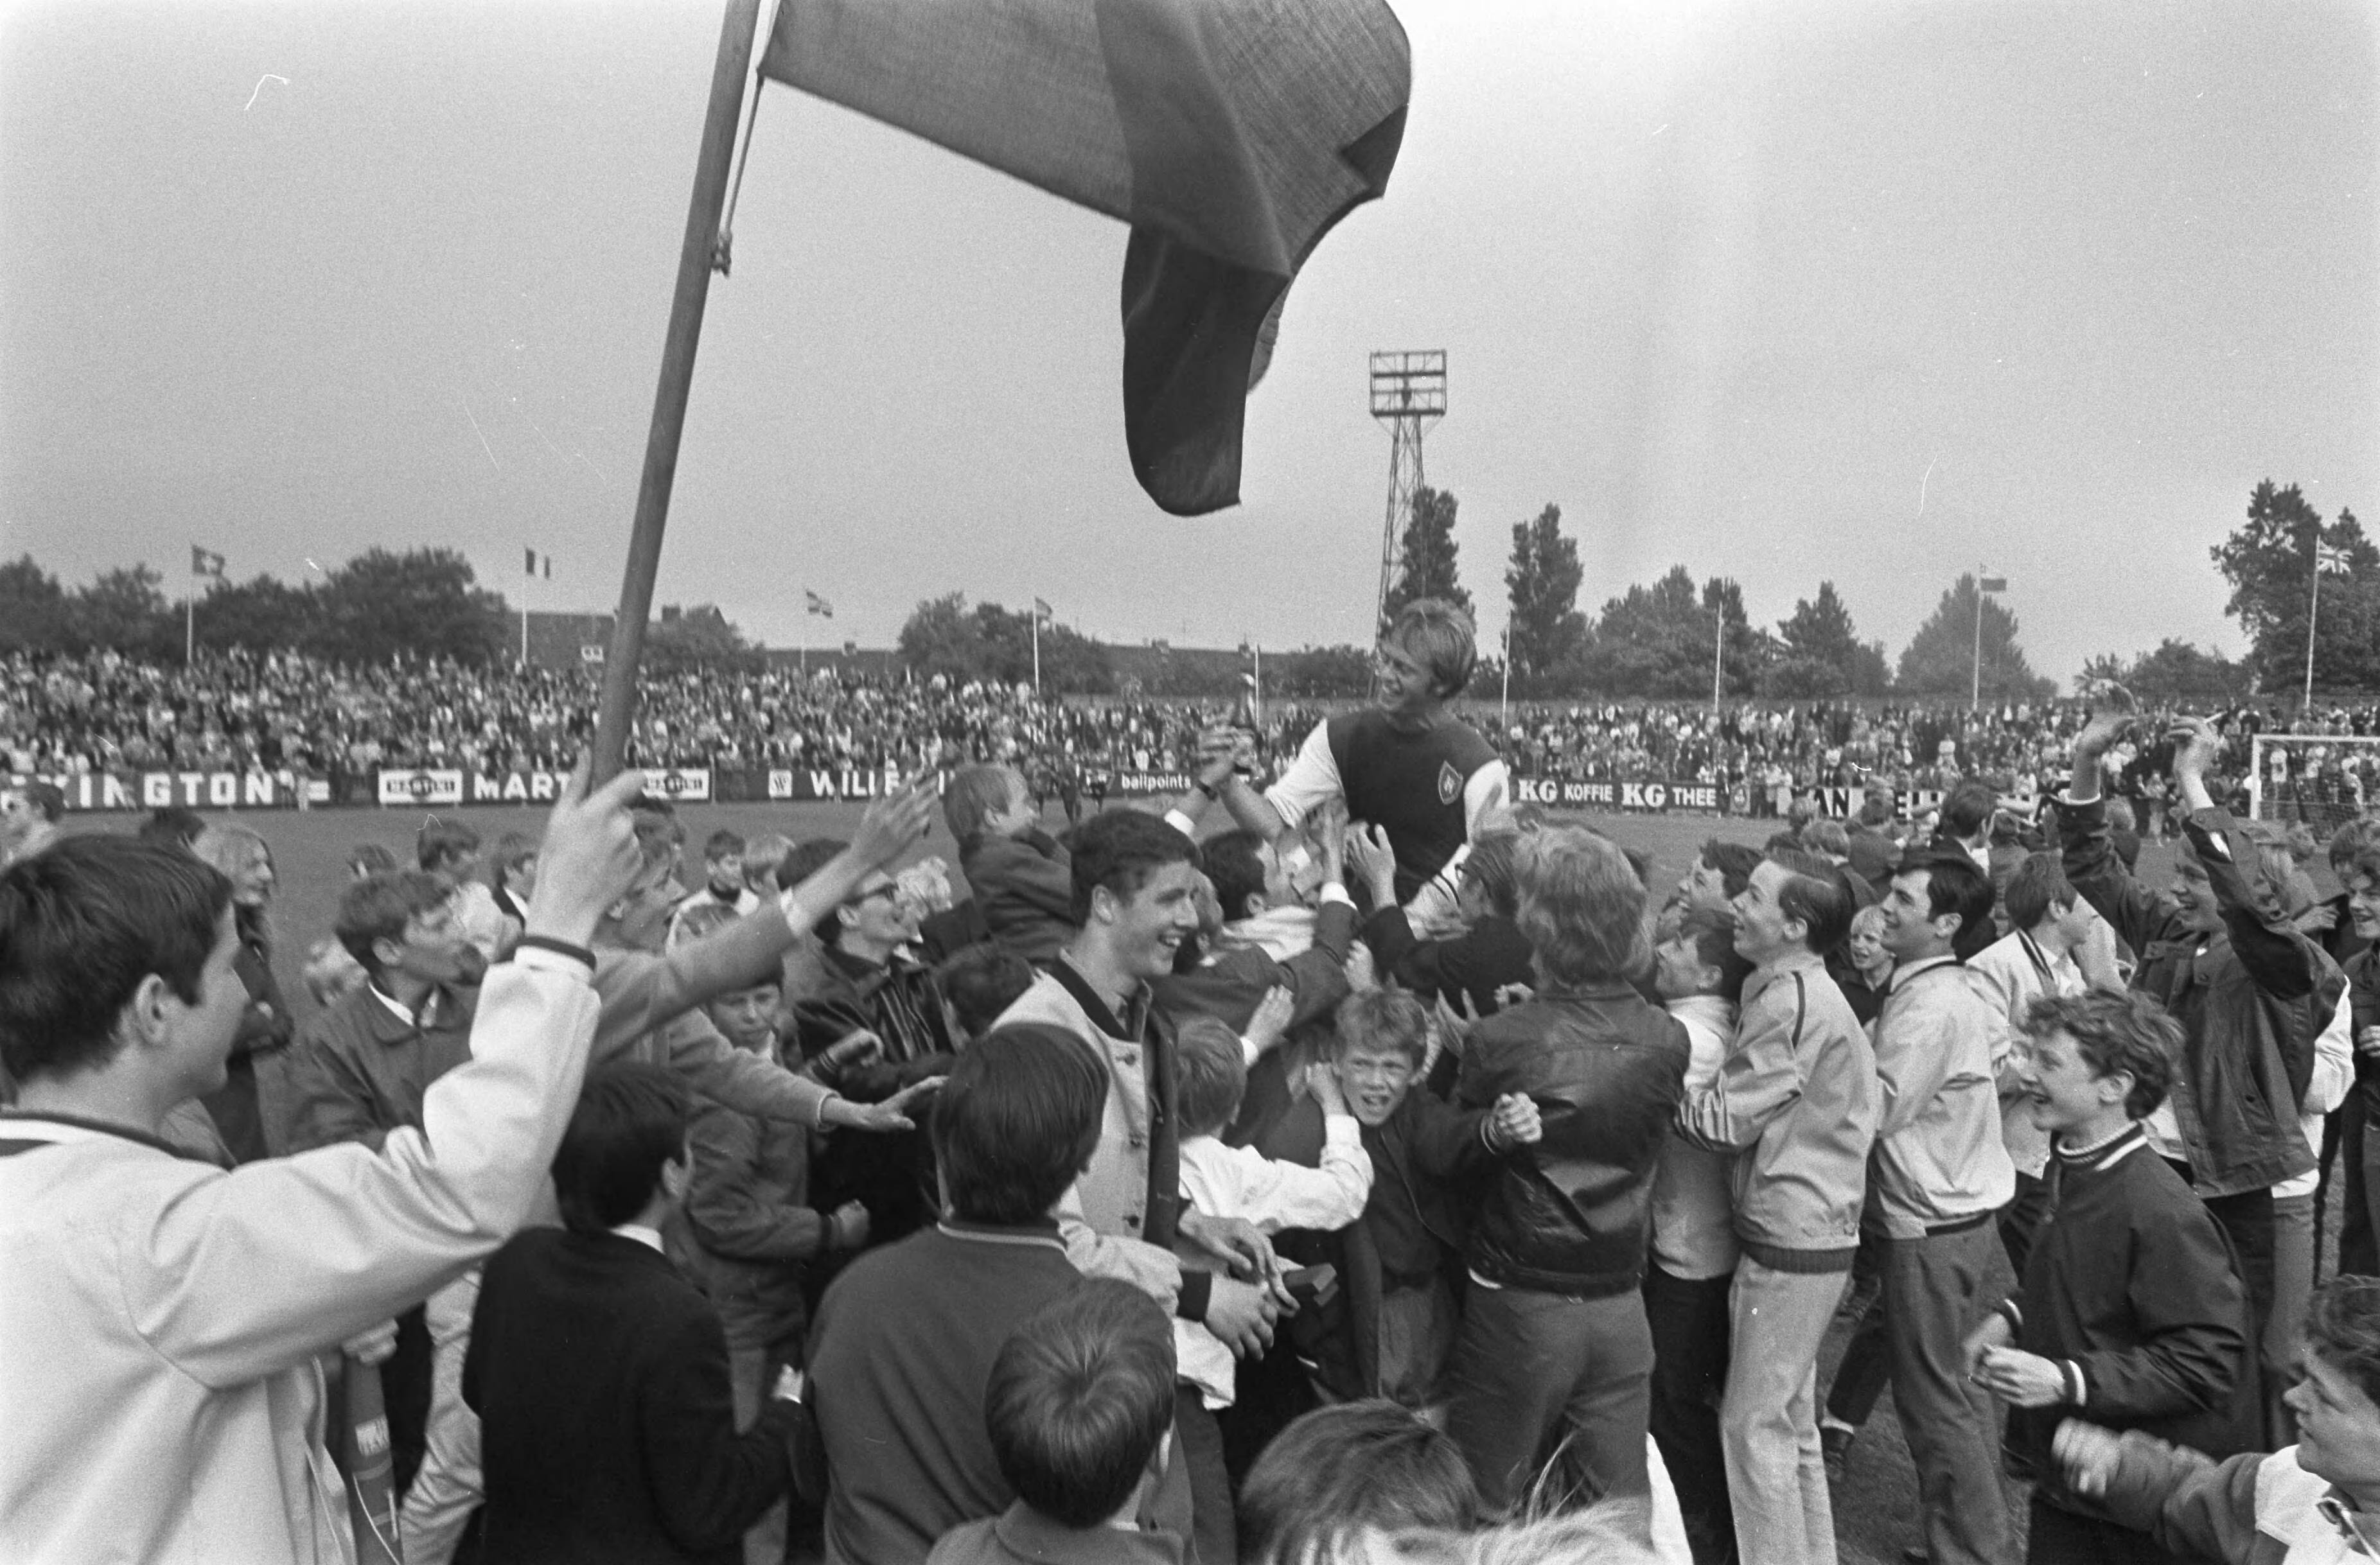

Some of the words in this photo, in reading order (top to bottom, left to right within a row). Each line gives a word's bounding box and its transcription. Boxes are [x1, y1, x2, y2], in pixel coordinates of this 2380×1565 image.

[11, 772, 274, 808] INGTON
[473, 773, 570, 800] MART
[1121, 773, 1192, 793] ballpoints
[1518, 779, 1558, 803] KG
[1564, 783, 1614, 802] KOFFIE
[1621, 782, 1666, 807] KG
[1672, 787, 1717, 807] THEE
